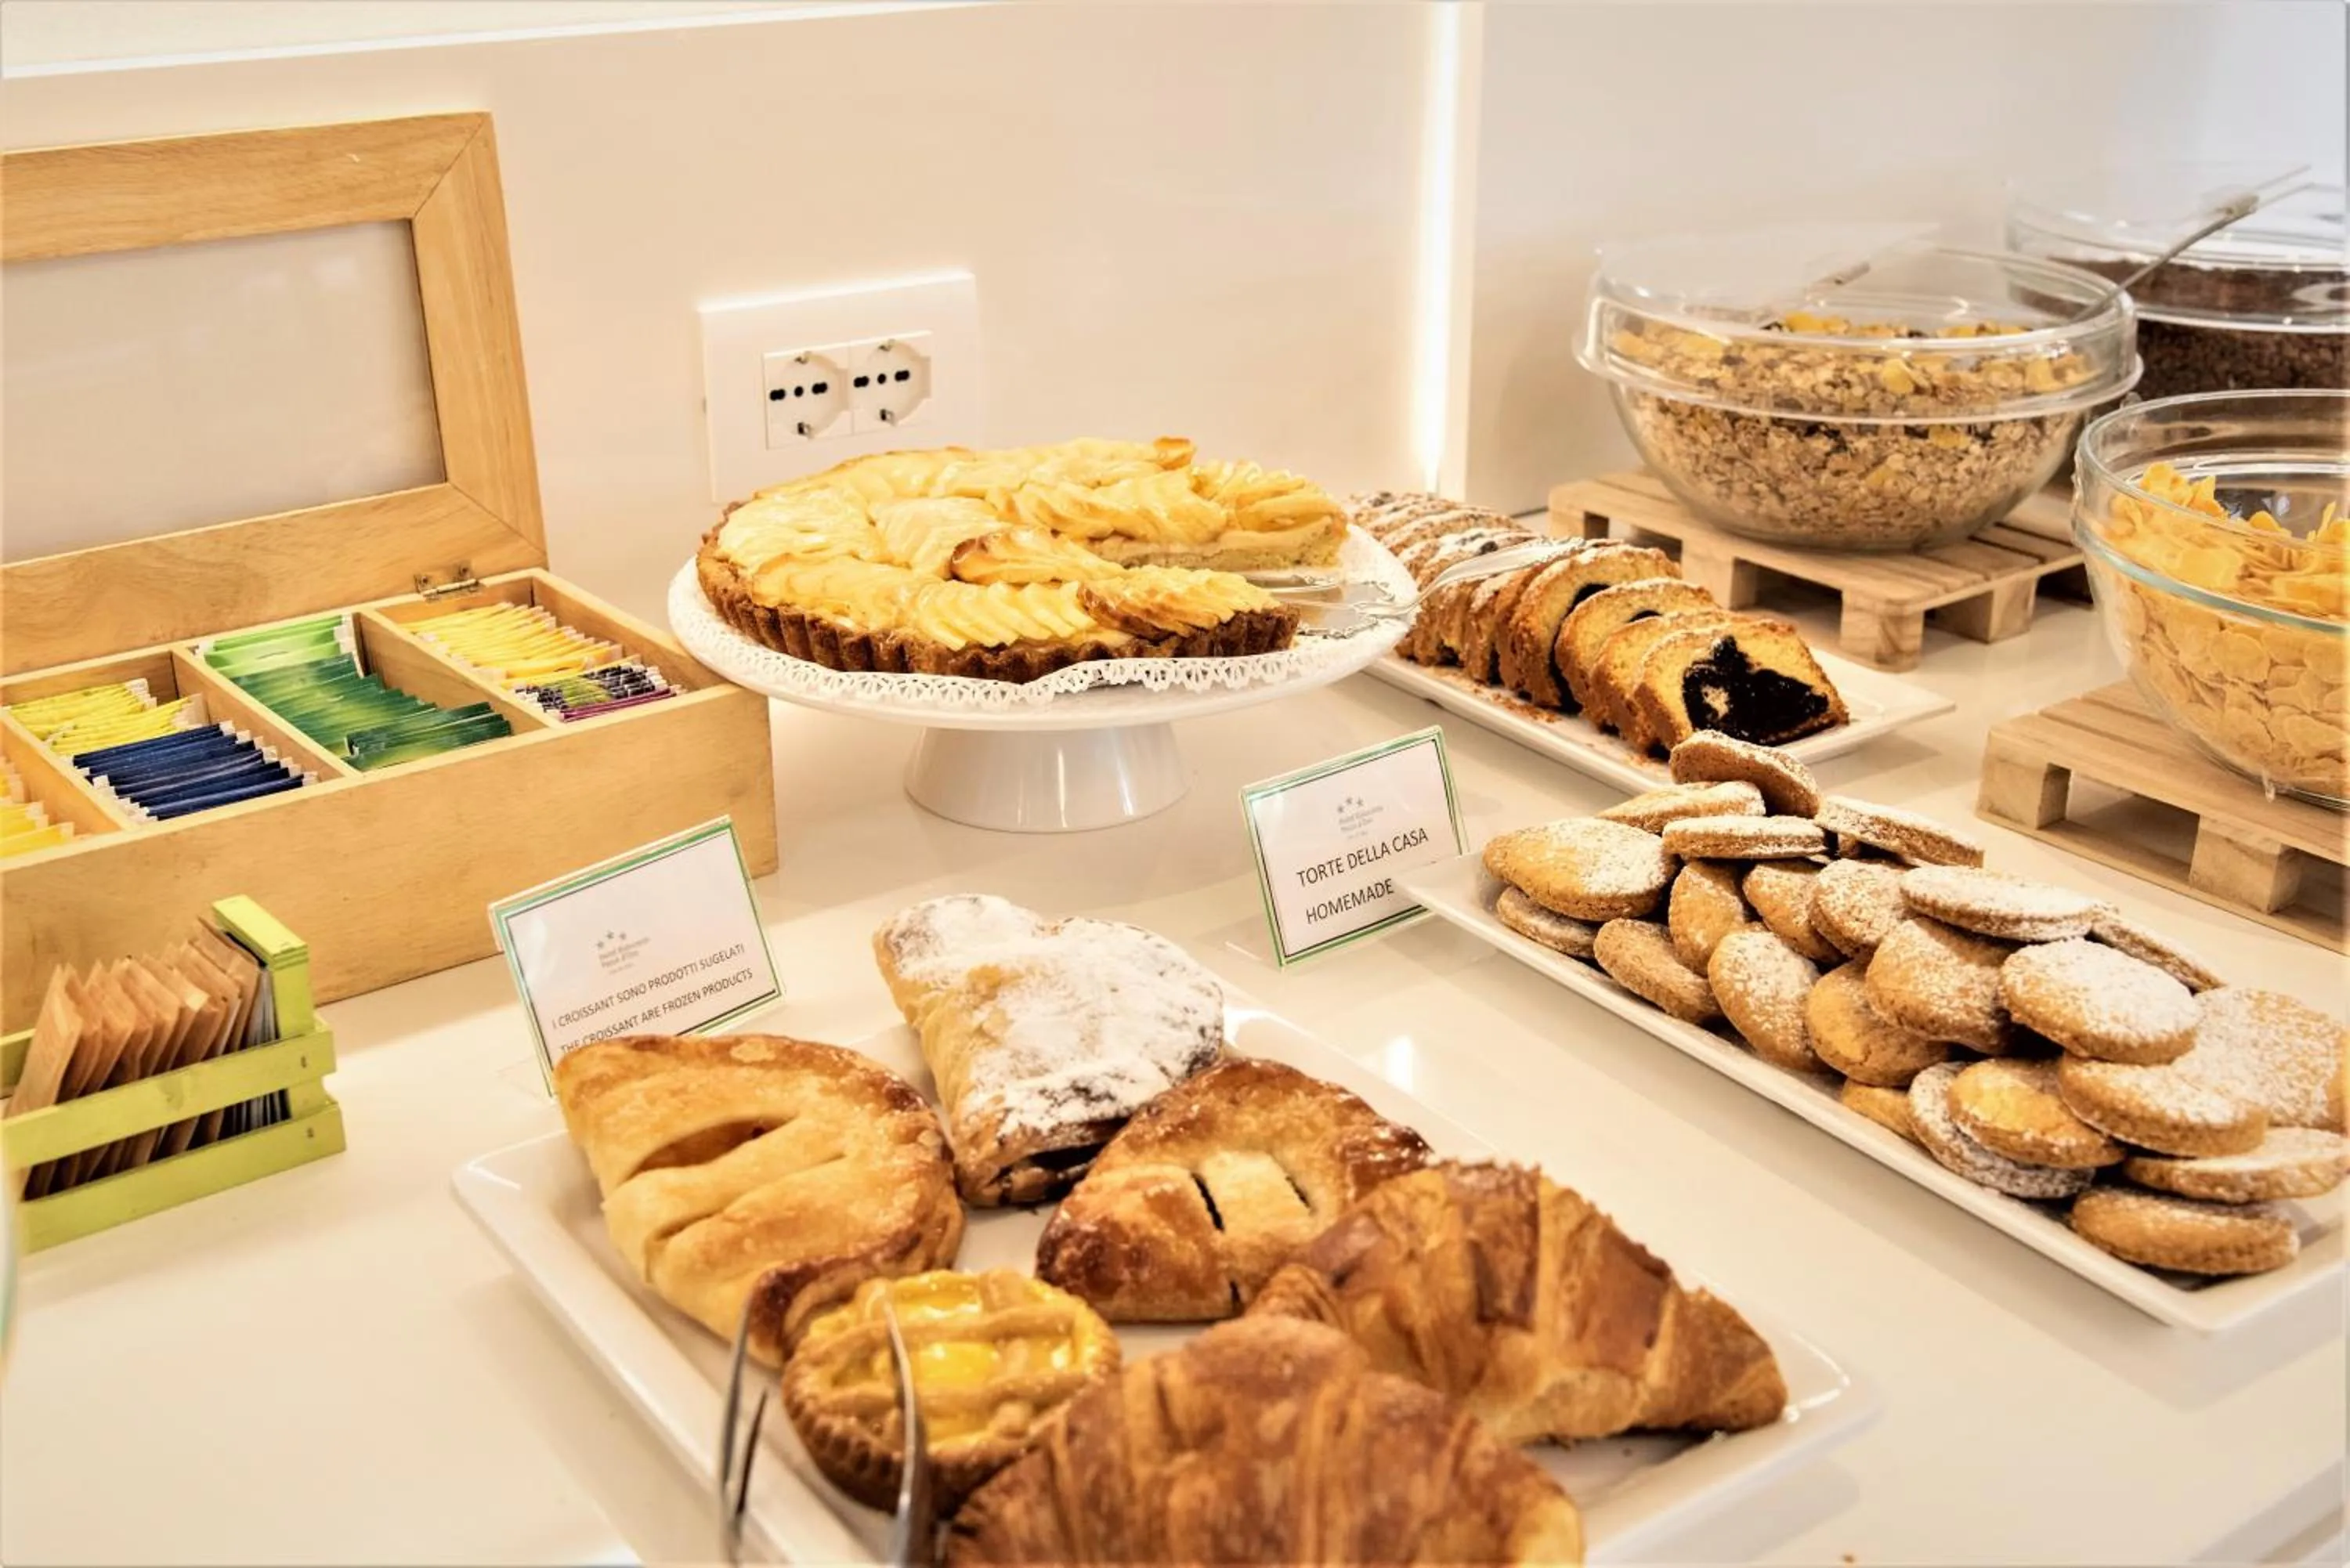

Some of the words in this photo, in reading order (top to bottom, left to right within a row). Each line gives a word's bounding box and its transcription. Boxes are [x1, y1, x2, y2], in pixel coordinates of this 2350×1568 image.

[1296, 858, 1344, 887] TORTE
[1347, 842, 1390, 870] DELLA
[1392, 828, 1429, 852] CASA
[1306, 878, 1394, 924] HOMEMADE
[551, 1019, 557, 1029] I
[559, 995, 614, 1027] CROISSANT
[616, 983, 647, 1003] SONO
[648, 962, 699, 990] PRODOTTI
[700, 943, 744, 970] SUGELATI
[583, 1015, 638, 1044] CROISSANT
[642, 1006, 661, 1023] ARE
[662, 990, 701, 1013] FROZEN
[702, 967, 753, 998] PRODUCTS
